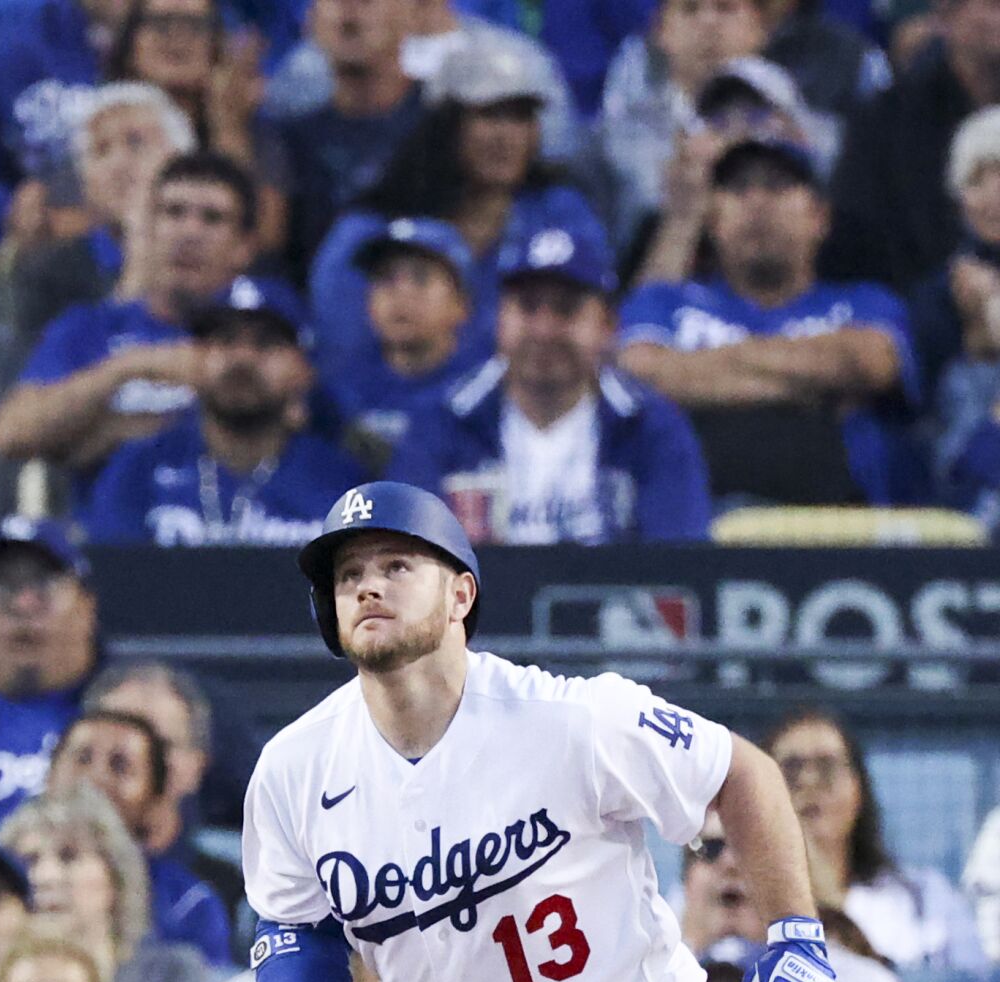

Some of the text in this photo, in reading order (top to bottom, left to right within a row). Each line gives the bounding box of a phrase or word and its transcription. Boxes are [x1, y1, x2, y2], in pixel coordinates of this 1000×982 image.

[341, 488, 373, 525] LA
[638, 706, 694, 751] LA
[316, 808, 571, 935] Dodgers
[273, 932, 297, 948] 13
